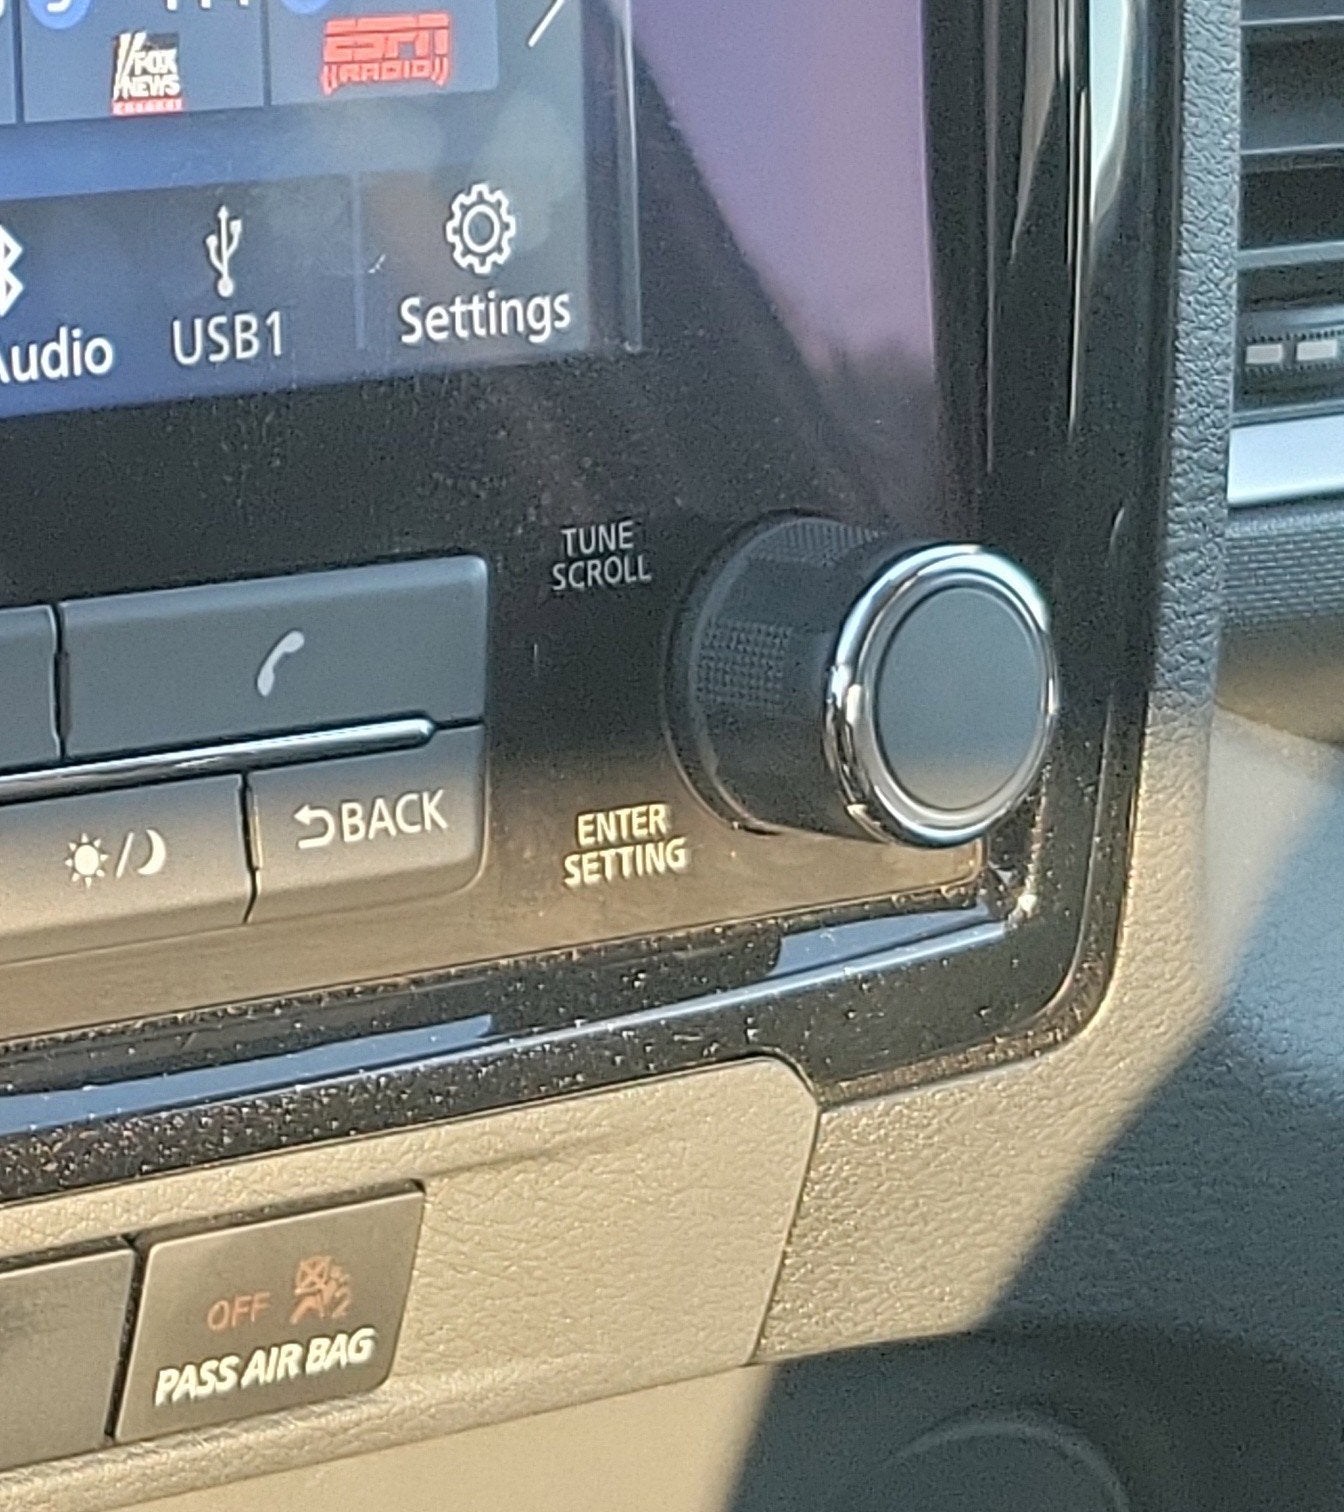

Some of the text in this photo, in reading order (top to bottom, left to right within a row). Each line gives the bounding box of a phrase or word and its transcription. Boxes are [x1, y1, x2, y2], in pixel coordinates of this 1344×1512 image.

[324, 14, 449, 63] ESPN
[133, 48, 178, 75] FOX
[339, 58, 433, 82] RADIO
[124, 74, 180, 97] NEWS
[171, 310, 283, 365] USB1
[399, 290, 571, 343] Settings
[561, 520, 634, 556] TUNE
[552, 554, 652, 591] SCROLL
[341, 790, 448, 844] BACK
[576, 803, 668, 847] ENTER
[564, 837, 686, 888] SETTING
[207, 1292, 270, 1331] OFF
[155, 1327, 378, 1406] PASS AIR BAG
